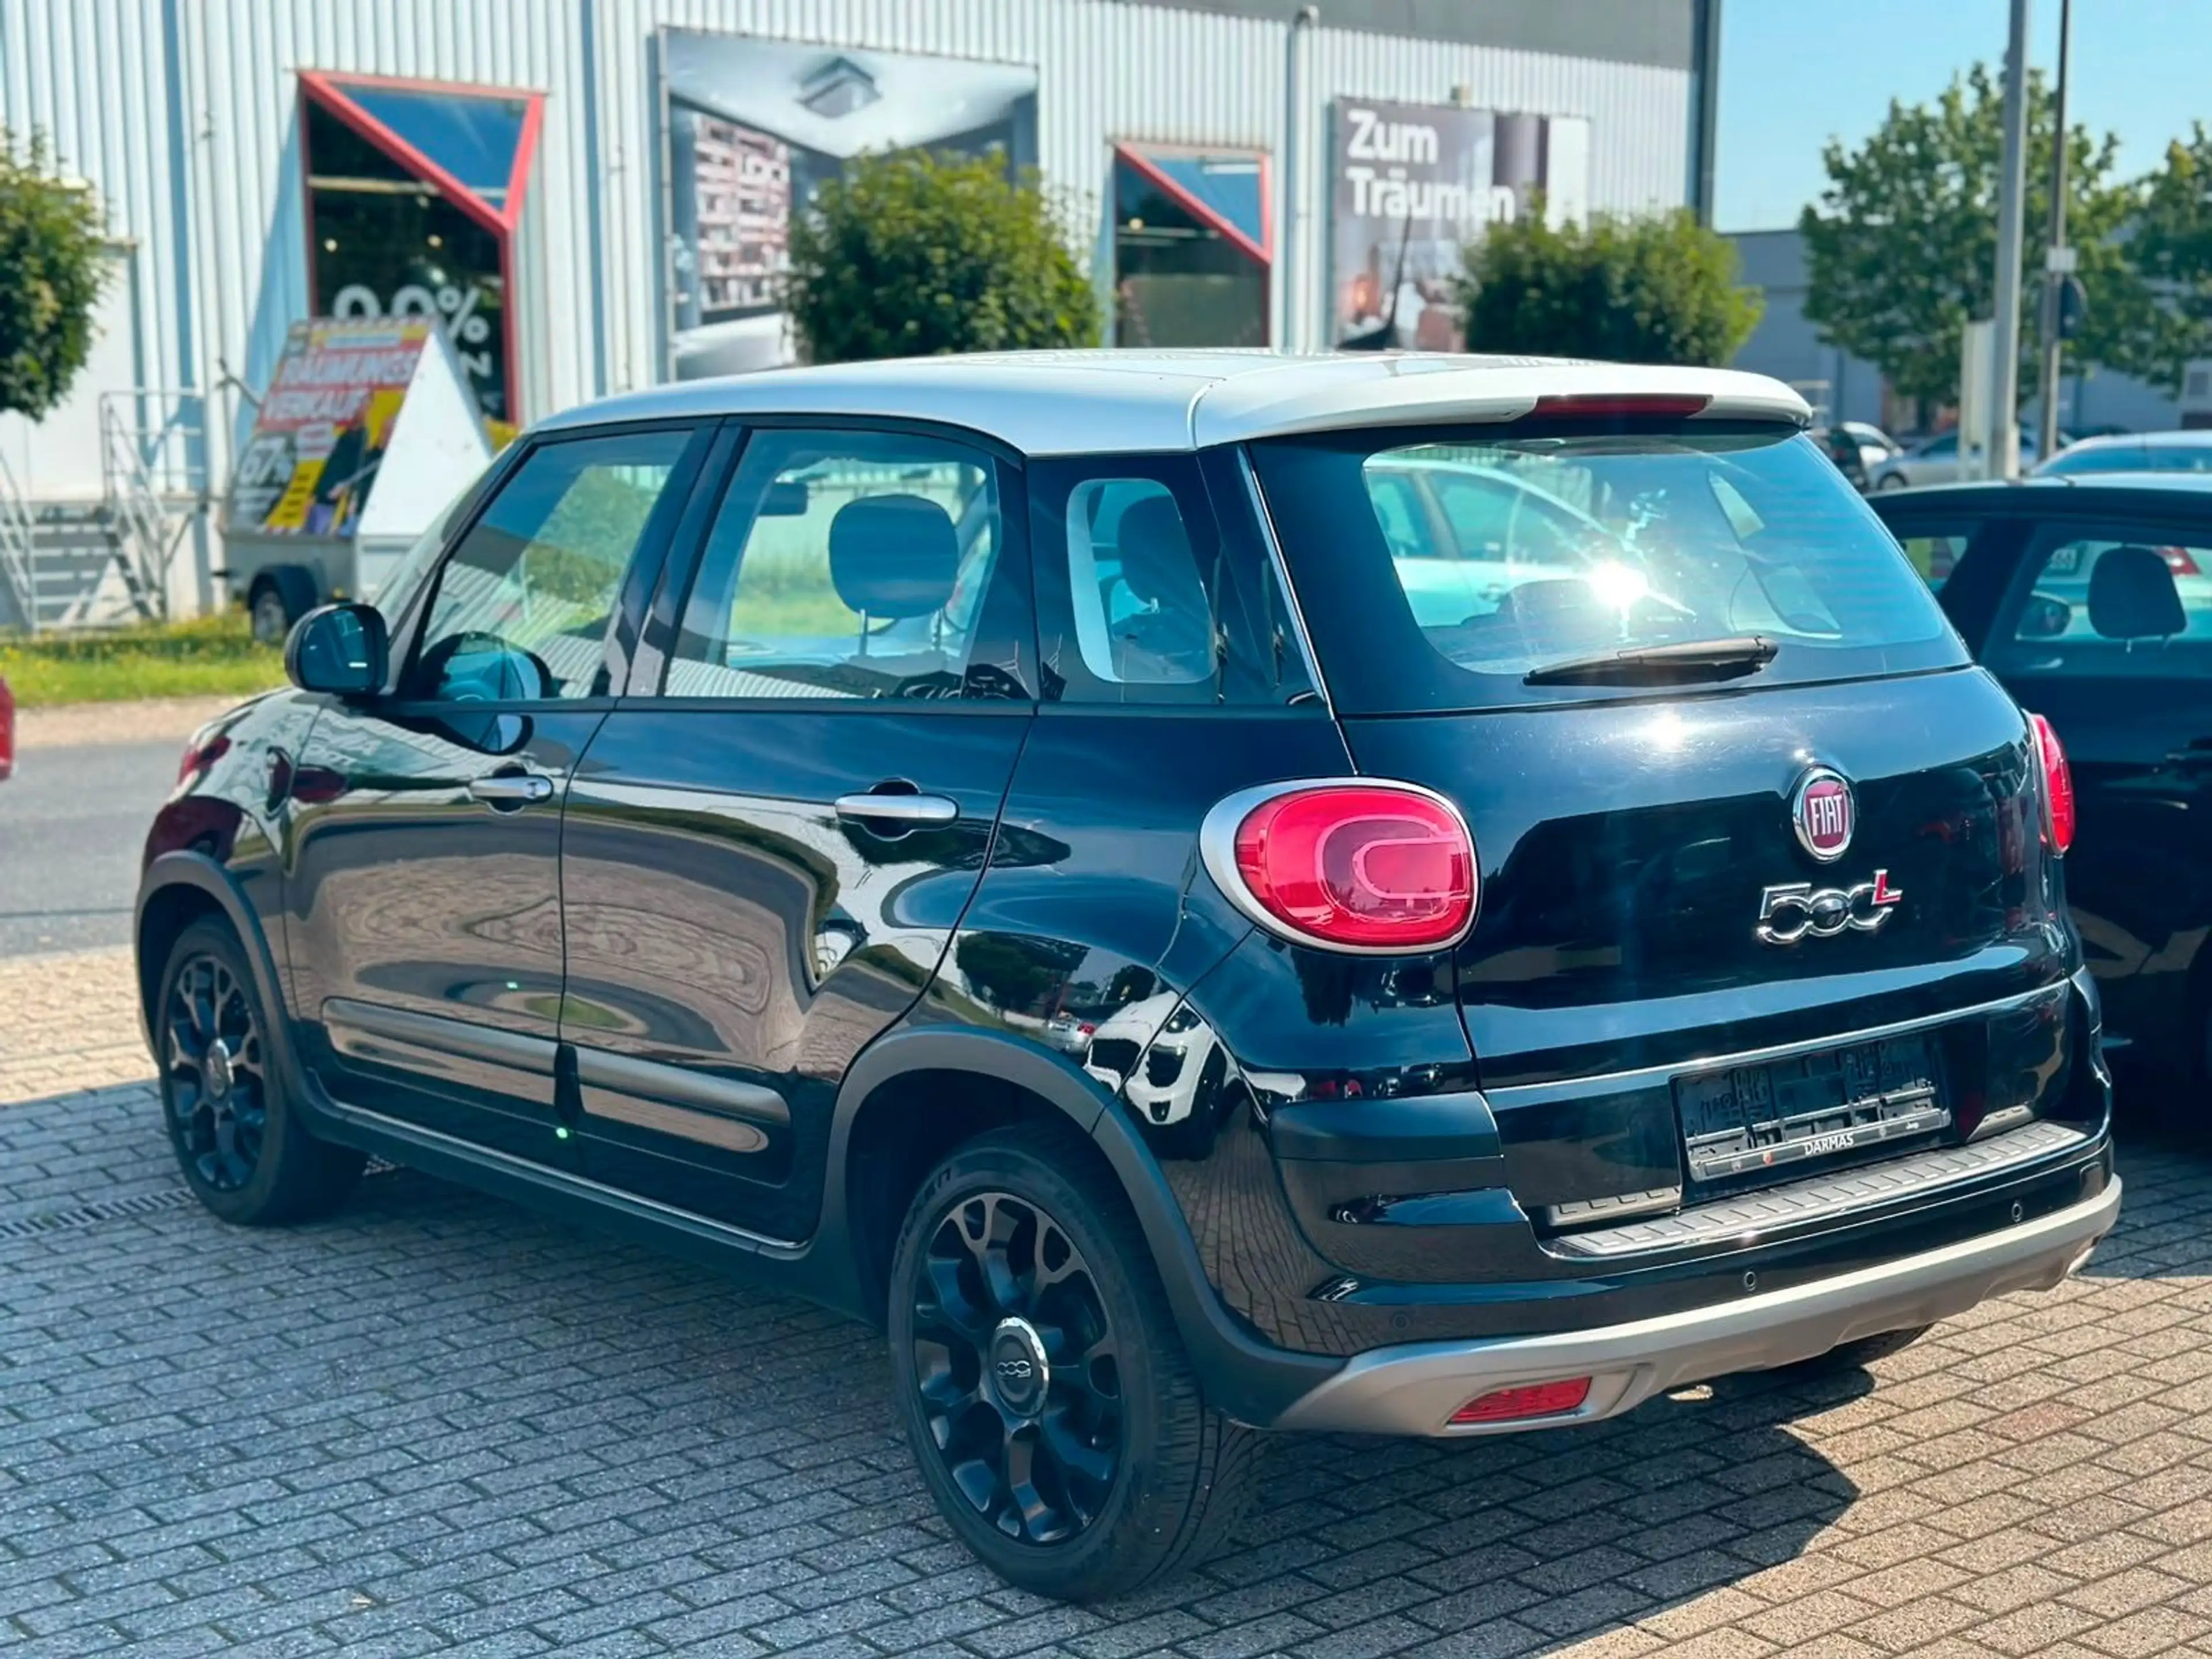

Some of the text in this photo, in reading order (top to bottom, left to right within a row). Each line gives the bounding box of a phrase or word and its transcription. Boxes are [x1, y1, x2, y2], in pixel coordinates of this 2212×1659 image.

[1347, 109, 1438, 164] Zum
[1345, 166, 1516, 225] Träumen
[1809, 794, 1843, 836] FIAT
[1804, 1132, 1854, 1156] DARMAS
